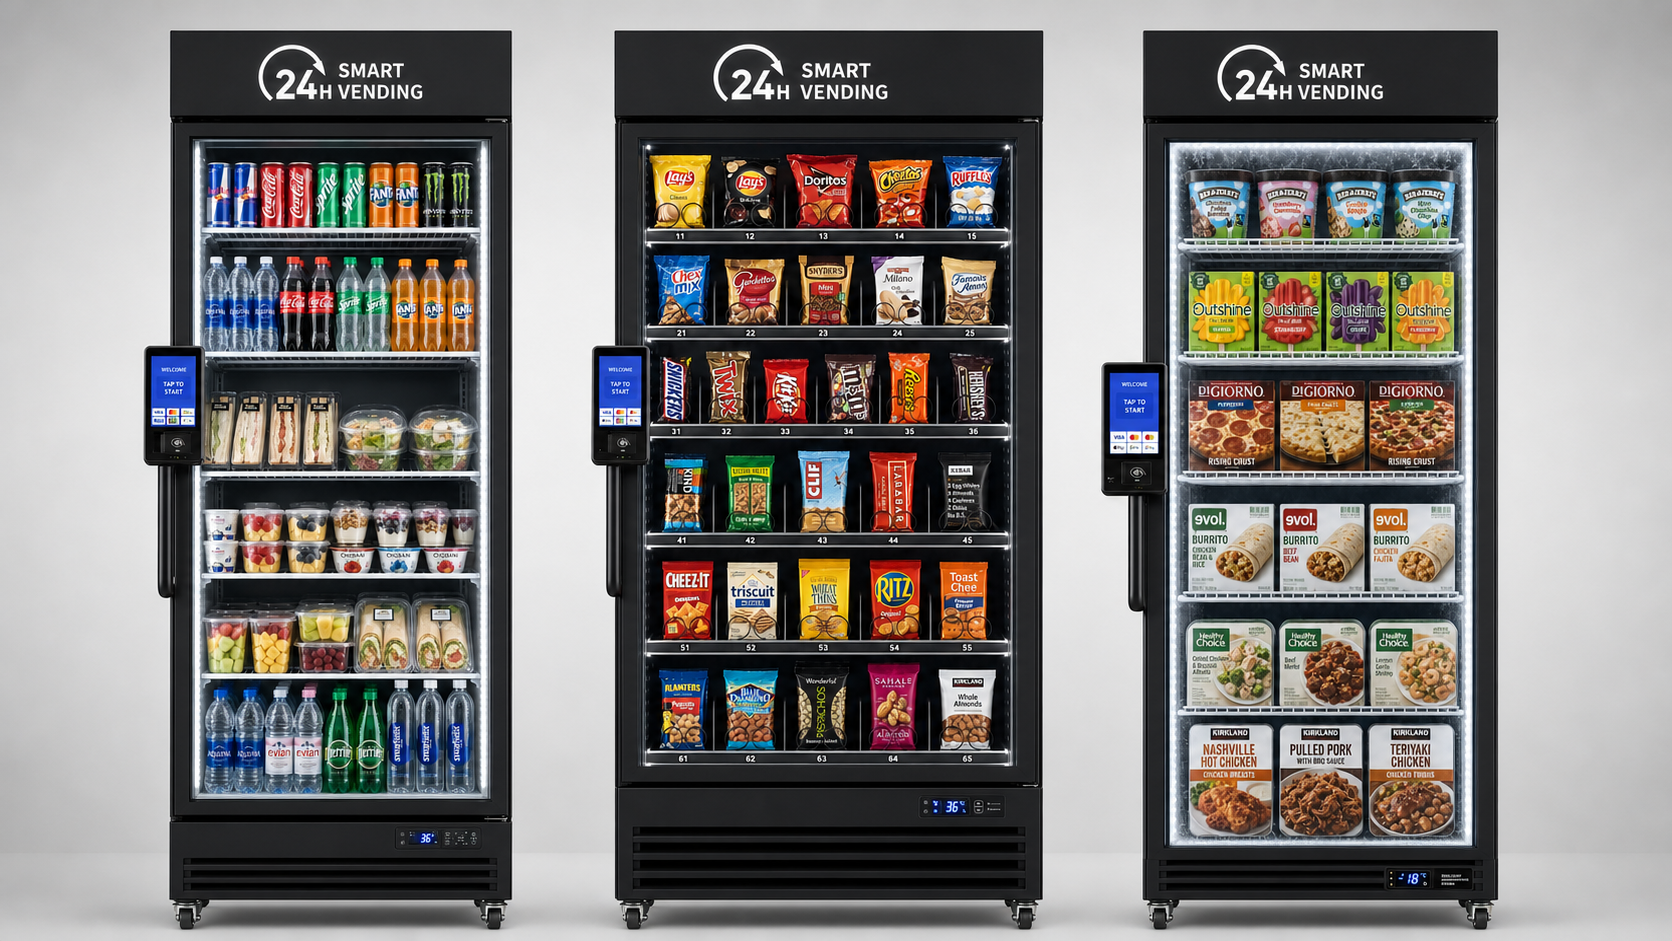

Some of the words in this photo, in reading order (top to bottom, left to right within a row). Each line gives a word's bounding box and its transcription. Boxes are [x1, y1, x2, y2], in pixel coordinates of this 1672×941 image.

[338, 63, 404, 79] SMART
[801, 63, 871, 78] SMART
[1299, 63, 1365, 78] SMART
[275, 68, 332, 100] 24H
[731, 69, 790, 100] 24H
[1235, 69, 1292, 100] 24H
[338, 84, 423, 100] VENDING
[800, 84, 888, 100] VENDING
[1298, 84, 1383, 100] VENDING
[666, 169, 694, 186] Lay's
[739, 176, 764, 189] Lay's
[804, 175, 846, 186] Doritos
[672, 268, 703, 284] Chex
[883, 274, 913, 283] Milano
[1193, 302, 1251, 317] Outshine
[1263, 302, 1319, 317] Outshine
[1331, 303, 1386, 318] Outshine
[1396, 303, 1451, 317] Outshine
[667, 361, 684, 421] SNICKERS
[683, 468, 693, 493] KIND
[808, 464, 820, 497] CLIF
[1192, 535, 1228, 544] BURRITO
[1283, 536, 1319, 545] BURRITO
[1373, 536, 1409, 545] BURRITO
[665, 572, 710, 589] CHEEZ-IT
[950, 572, 978, 582] Toast
[731, 585, 775, 597] triscuit
[877, 577, 912, 602] RITZ
[951, 582, 977, 592] Chee
[1199, 632, 1224, 641] Healthy
[1291, 632, 1316, 641] Healthy
[1382, 632, 1407, 640] Healthy
[1196, 639, 1225, 647] Choice
[1288, 639, 1317, 647] Choice
[1379, 639, 1408, 647] Choice
[875, 677, 912, 685] SAHALE
[268, 749, 290, 757] evian
[296, 749, 319, 757] evian
[1203, 744, 1255, 755] NASHVILLE
[1290, 744, 1324, 756] PULLED
[1327, 744, 1352, 756] PORK
[1390, 744, 1430, 755] TERIYAKI
[1201, 756, 1216, 768] HOT
[1219, 756, 1257, 768] CHICKEN
[1391, 756, 1430, 767] CHICKEN
